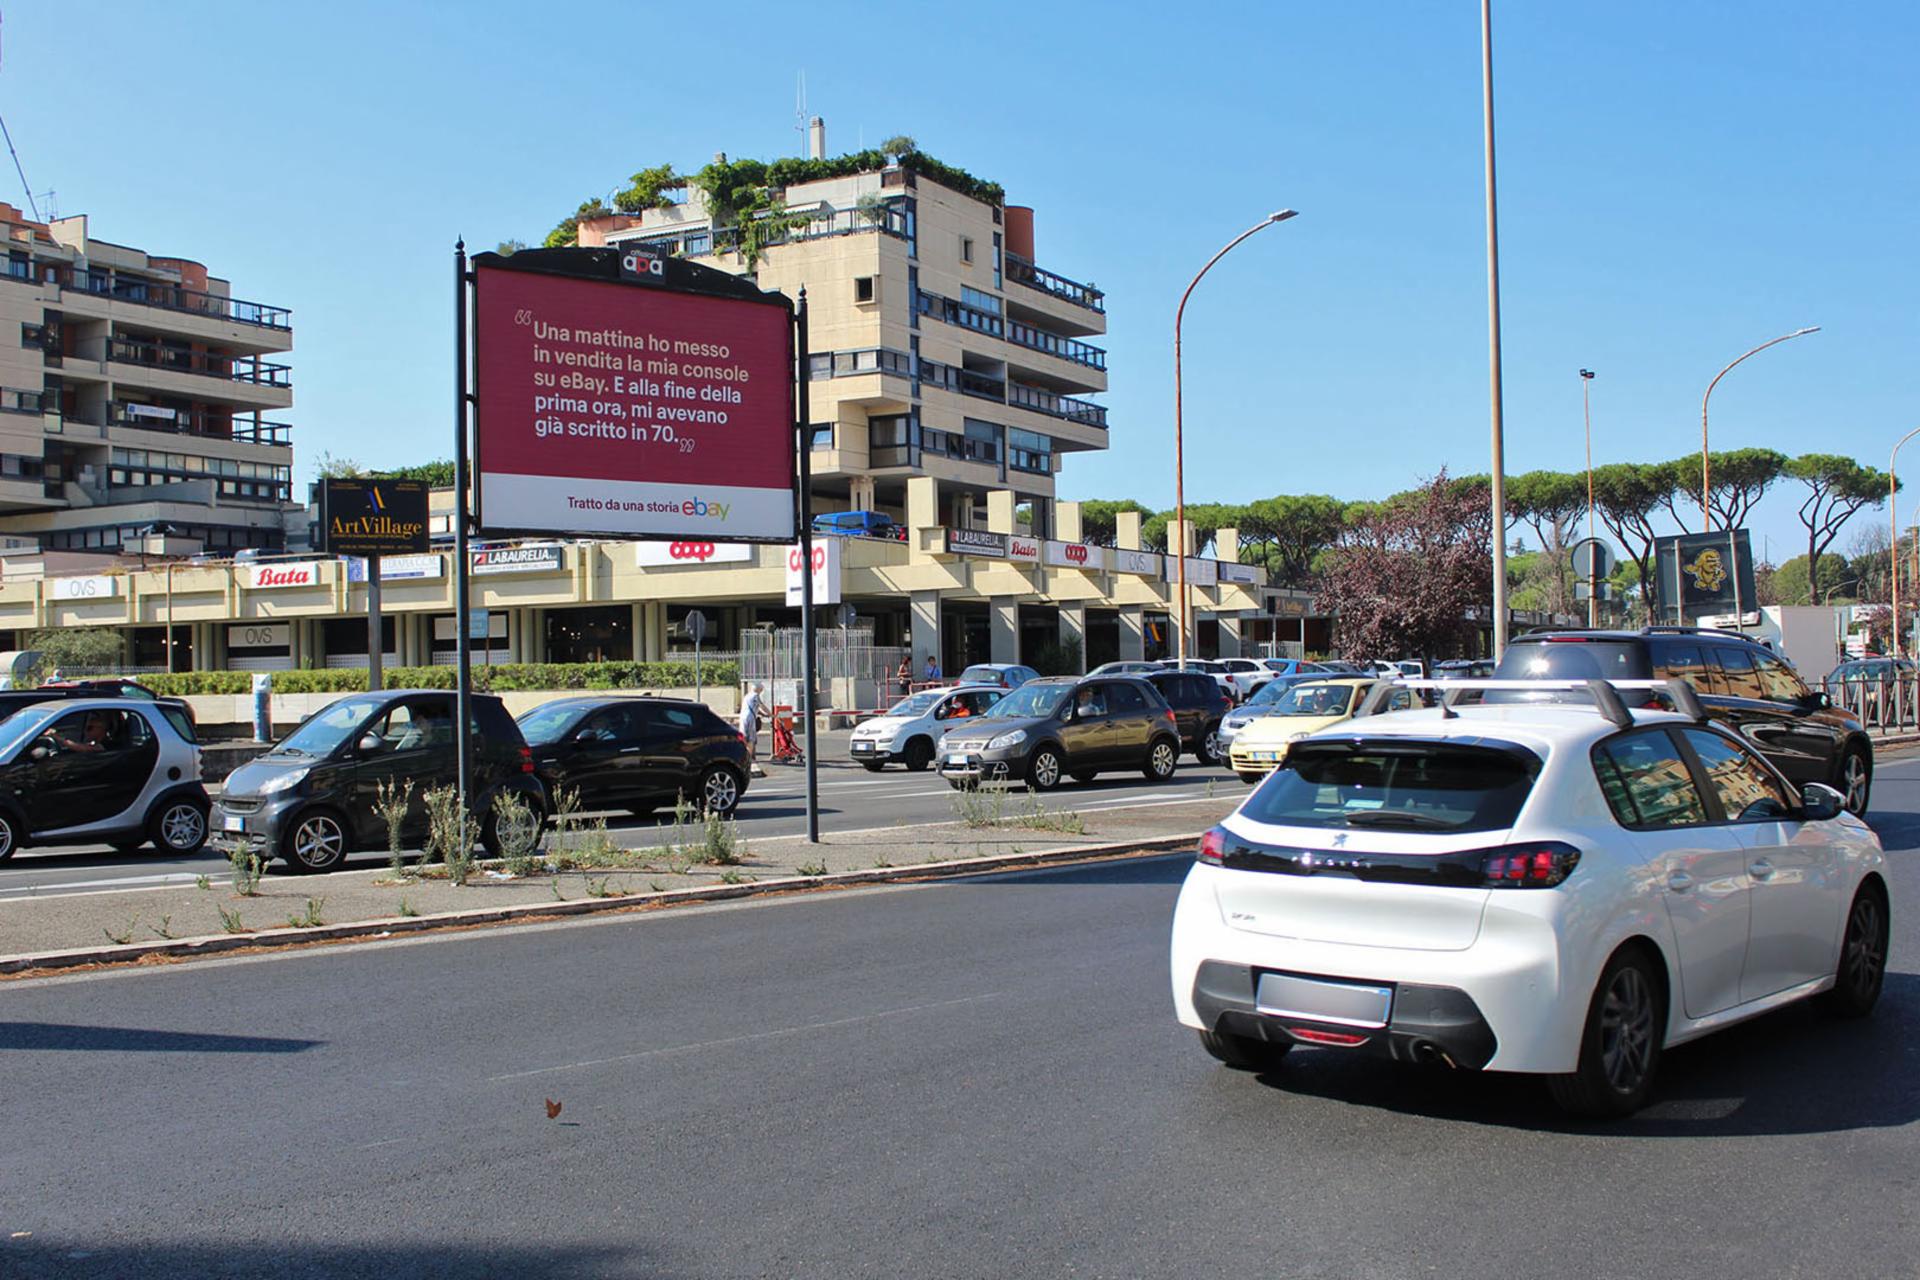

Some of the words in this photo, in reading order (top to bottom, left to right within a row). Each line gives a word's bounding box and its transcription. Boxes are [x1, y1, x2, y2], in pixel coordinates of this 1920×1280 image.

[623, 256, 663, 275] apa
[575, 330, 644, 350] mattina
[649, 334, 670, 352] ho
[674, 341, 730, 358] messo
[534, 344, 550, 363] in
[555, 351, 623, 370] vendita
[628, 354, 643, 372] la
[647, 357, 678, 376] mia
[682, 365, 749, 382] console
[534, 372, 555, 387] su
[560, 372, 609, 395] eBay.
[614, 376, 624, 393] E
[628, 378, 660, 397] alla
[664, 380, 696, 399] fine
[700, 385, 742, 404] della
[535, 393, 588, 413] prima
[592, 401, 627, 420] ora,
[631, 401, 652, 419] mi
[656, 405, 728, 425] avevano
[535, 416, 564, 437] già
[568, 420, 627, 439] scritto
[631, 423, 647, 441] in
[567, 496, 603, 510] Tratto
[605, 499, 620, 511] da
[623, 501, 644, 512] una
[647, 501, 680, 513] storia
[682, 496, 730, 521] ebay
[331, 516, 423, 540] ArtVillage
[488, 548, 549, 564] LABAURELIA
[669, 541, 716, 562] coop
[1010, 540, 1037, 557] Bata
[70, 578, 96, 596] OVS
[256, 567, 309, 585] Bata
[245, 627, 272, 644] OVS
